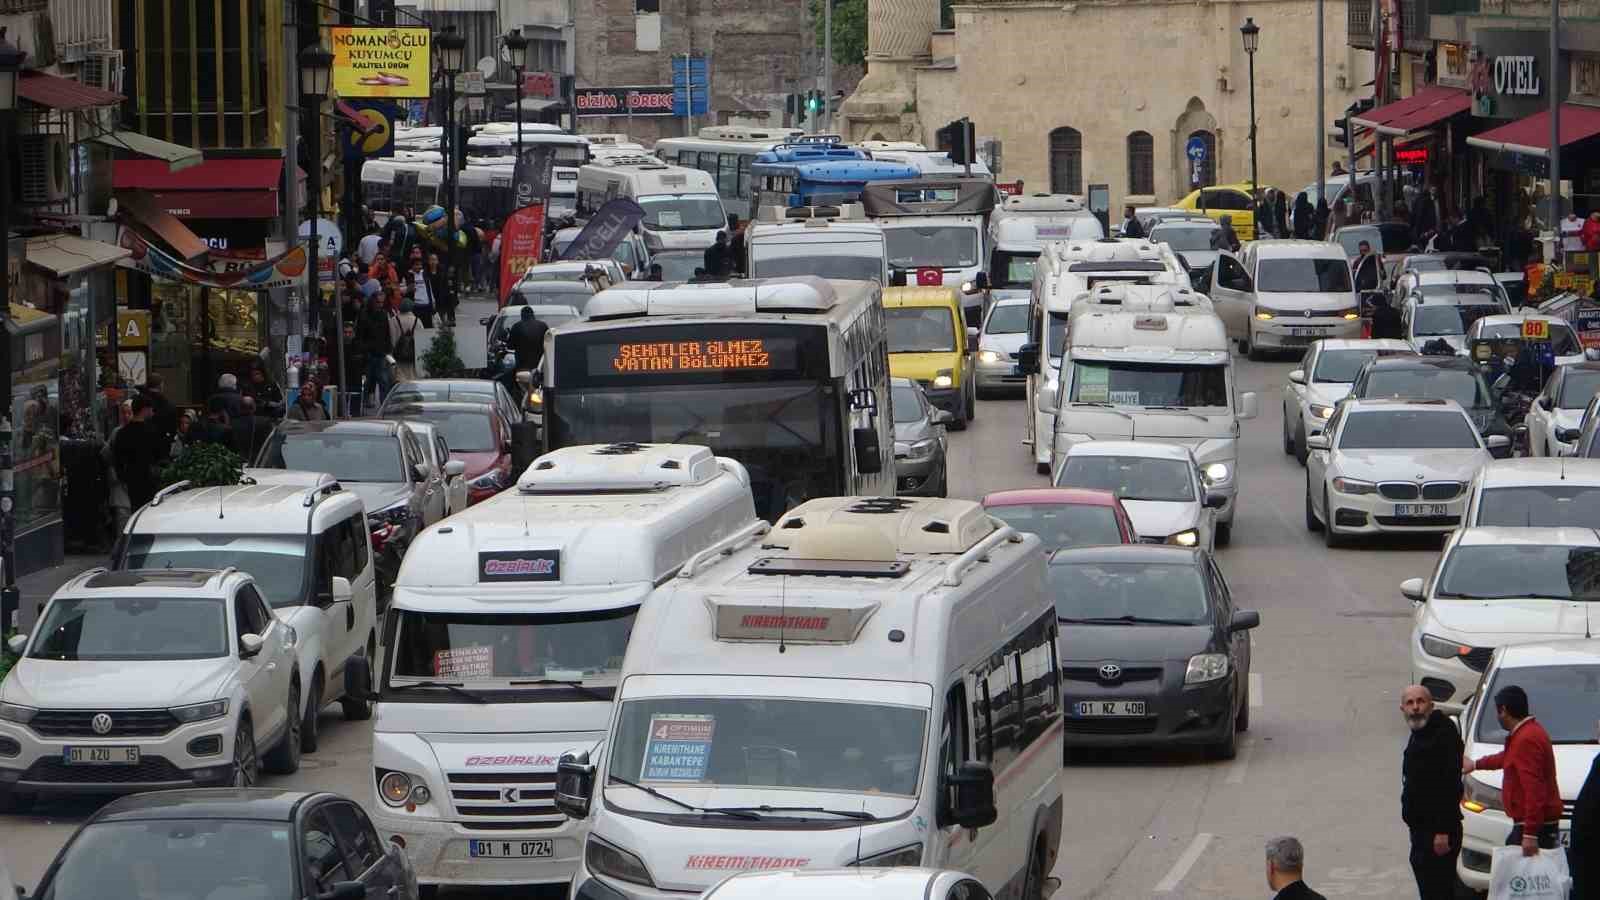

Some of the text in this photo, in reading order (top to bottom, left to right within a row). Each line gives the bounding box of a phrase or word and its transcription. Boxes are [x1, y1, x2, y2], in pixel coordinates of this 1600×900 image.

[1494, 55, 1539, 95] OTEL
[1080, 703, 1093, 714] 01
[1102, 703, 1115, 714] NZ
[655, 725, 668, 738] 4
[71, 748, 137, 761] 01 AZU 15
[478, 842, 492, 856] 01
[521, 842, 551, 856] 0724
